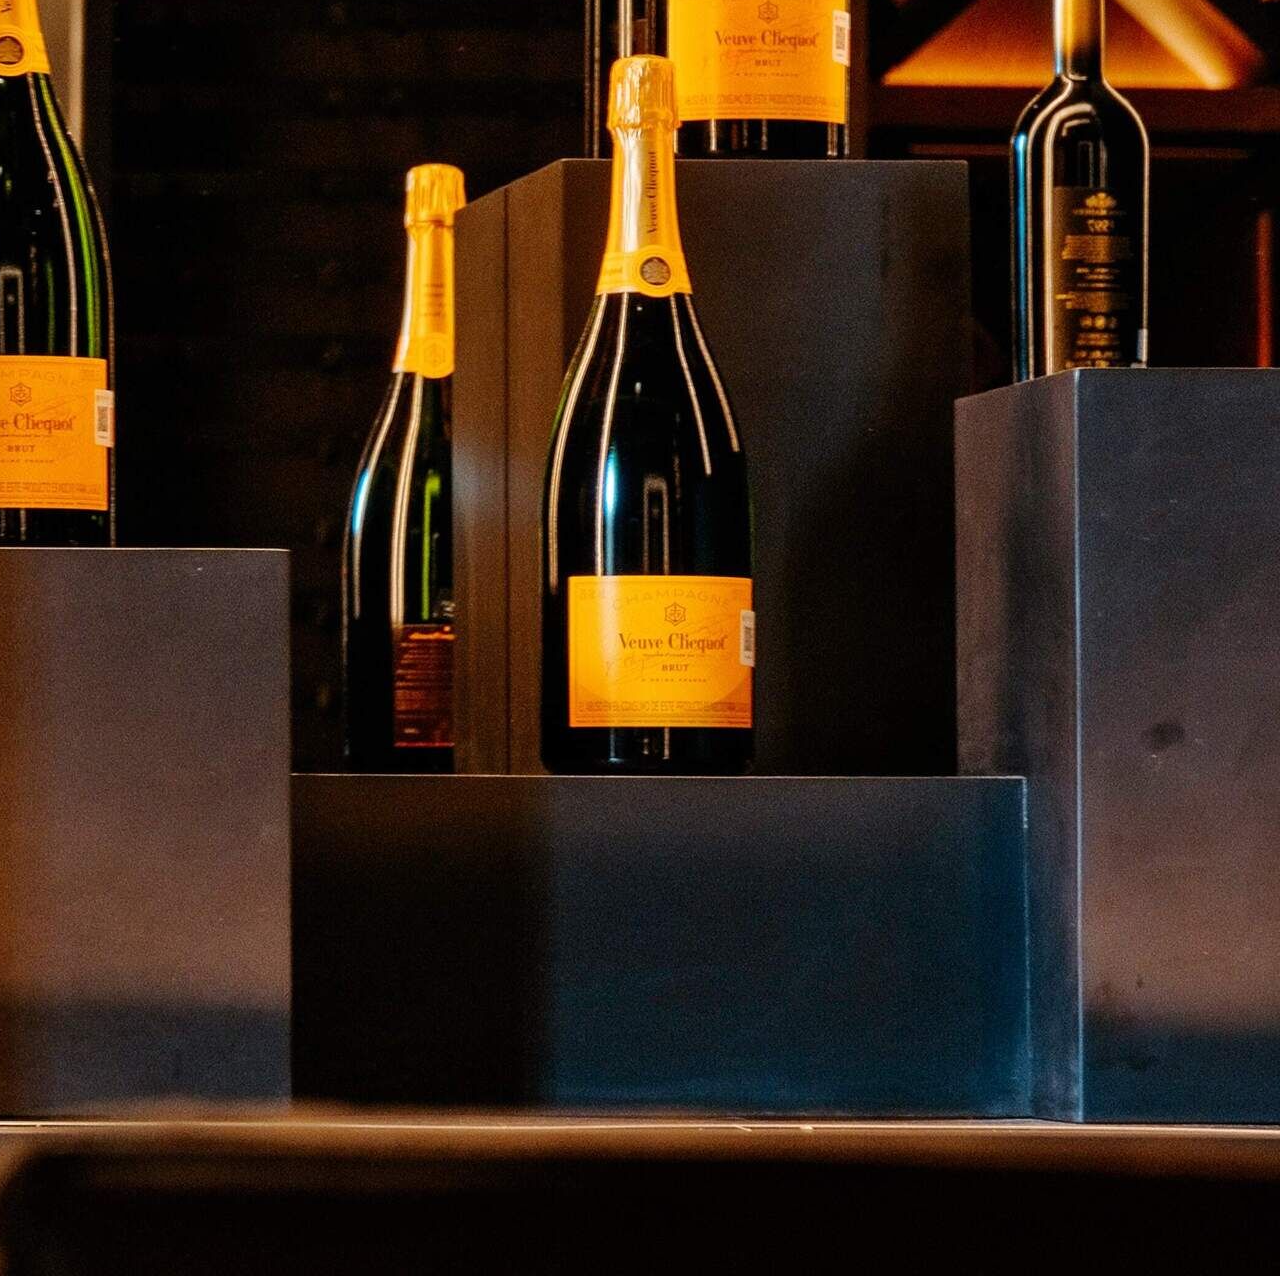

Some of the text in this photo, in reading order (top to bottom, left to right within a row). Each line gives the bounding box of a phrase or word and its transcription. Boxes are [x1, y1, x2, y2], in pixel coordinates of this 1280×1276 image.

[715, 28, 818, 51] Veuve Clicquot
[644, 151, 660, 235] Veuve Clicquot
[12, 411, 74, 436] Clicquot
[618, 631, 728, 655] Veuve Clicquot
[661, 663, 689, 672] BRUT
